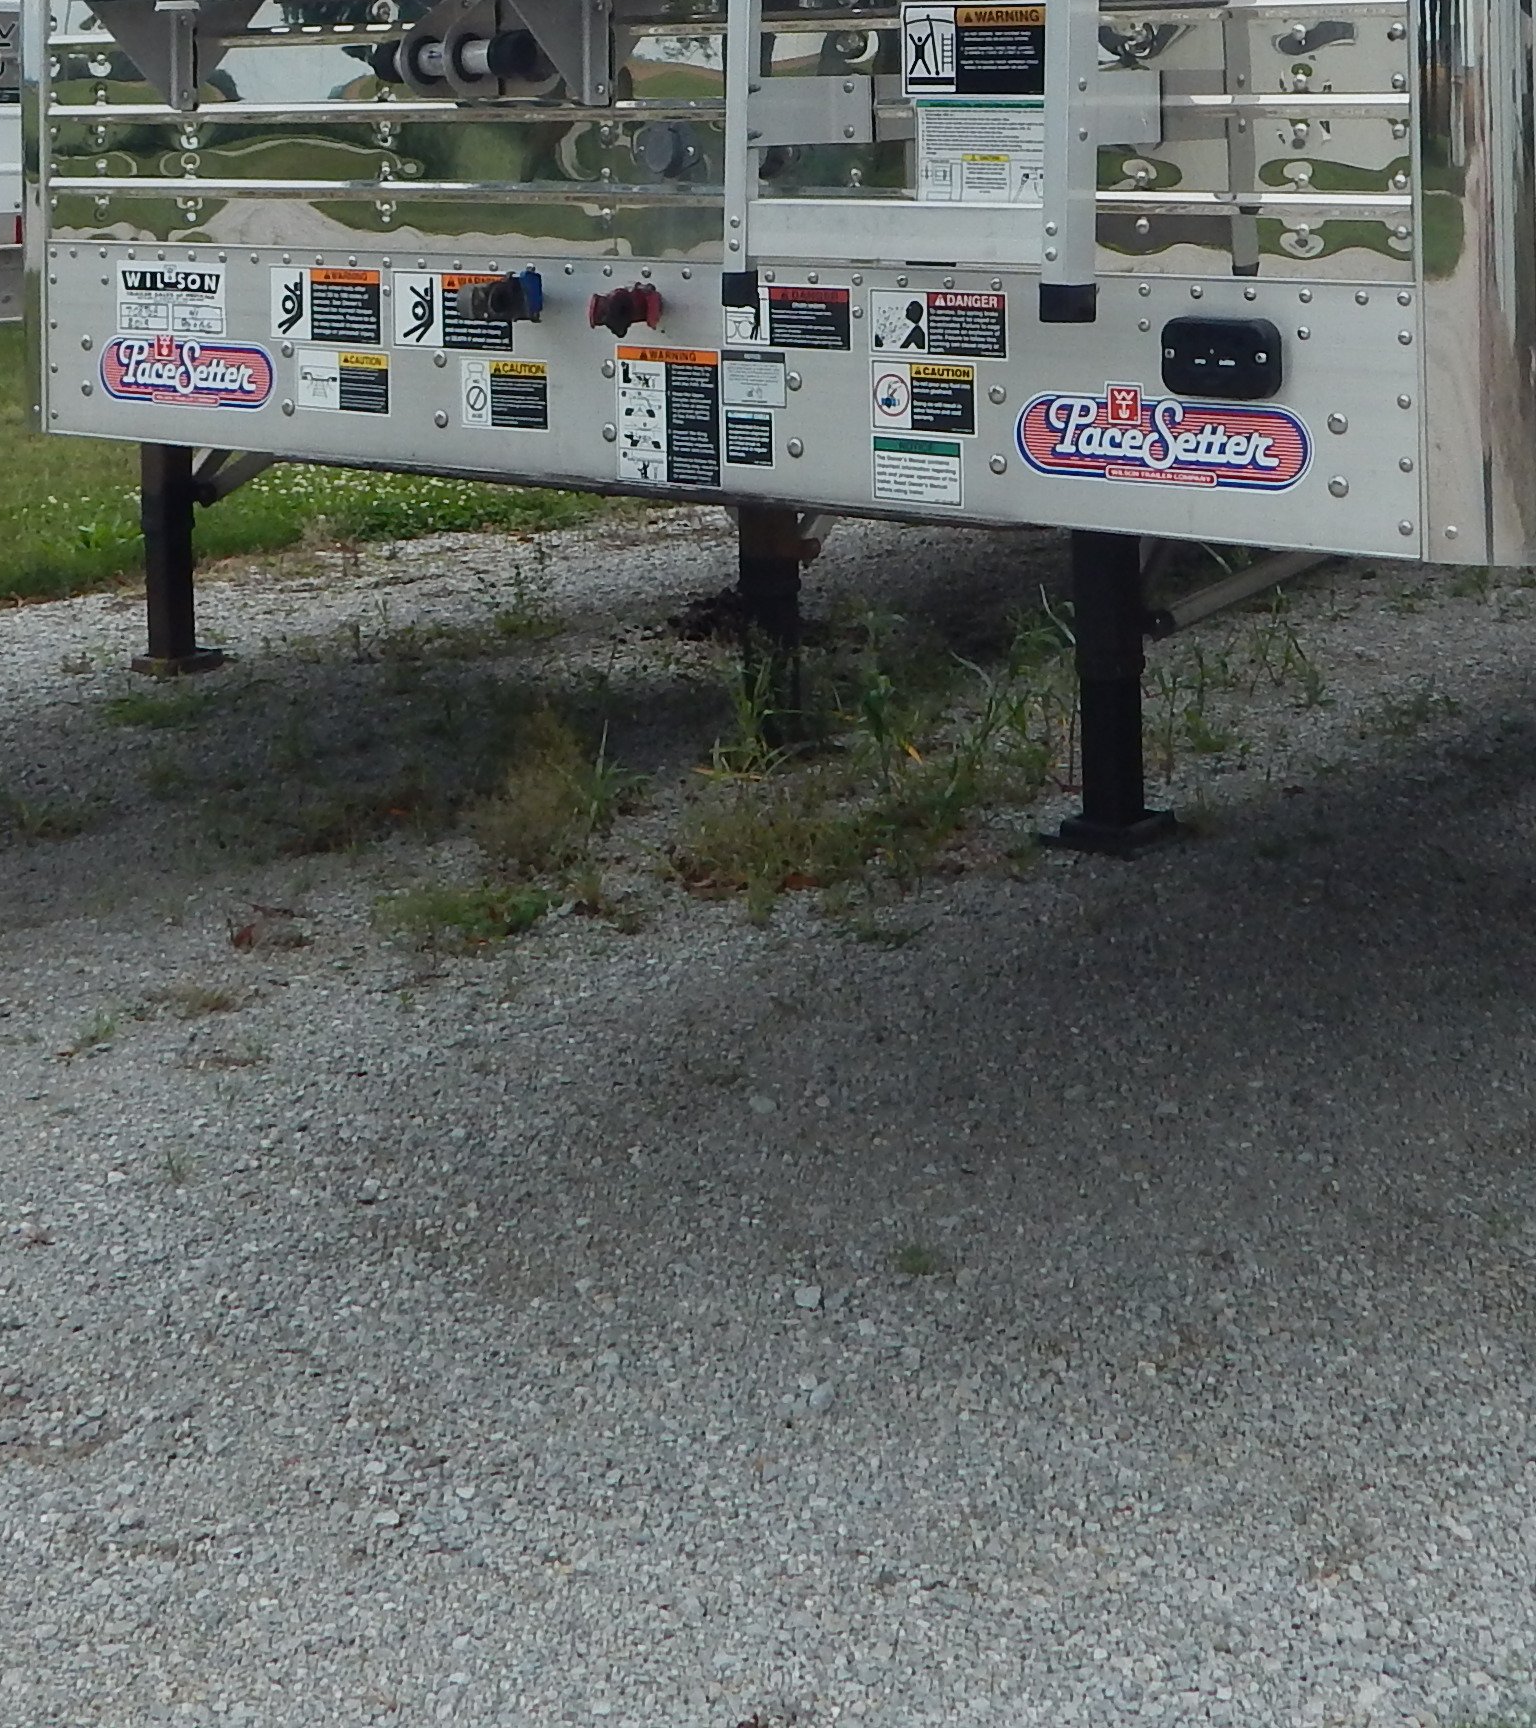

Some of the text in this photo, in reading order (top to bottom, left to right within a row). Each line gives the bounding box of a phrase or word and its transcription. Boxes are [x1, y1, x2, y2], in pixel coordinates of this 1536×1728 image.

[974, 9, 1040, 23] WARNING
[126, 272, 217, 292] WILSON
[330, 271, 368, 281] WARNING
[946, 294, 998, 308] DANGER
[348, 355, 382, 367] CAUTION
[648, 351, 697, 362] WARNING
[502, 363, 545, 375] CAUTION
[922, 368, 970, 378] CAUTION
